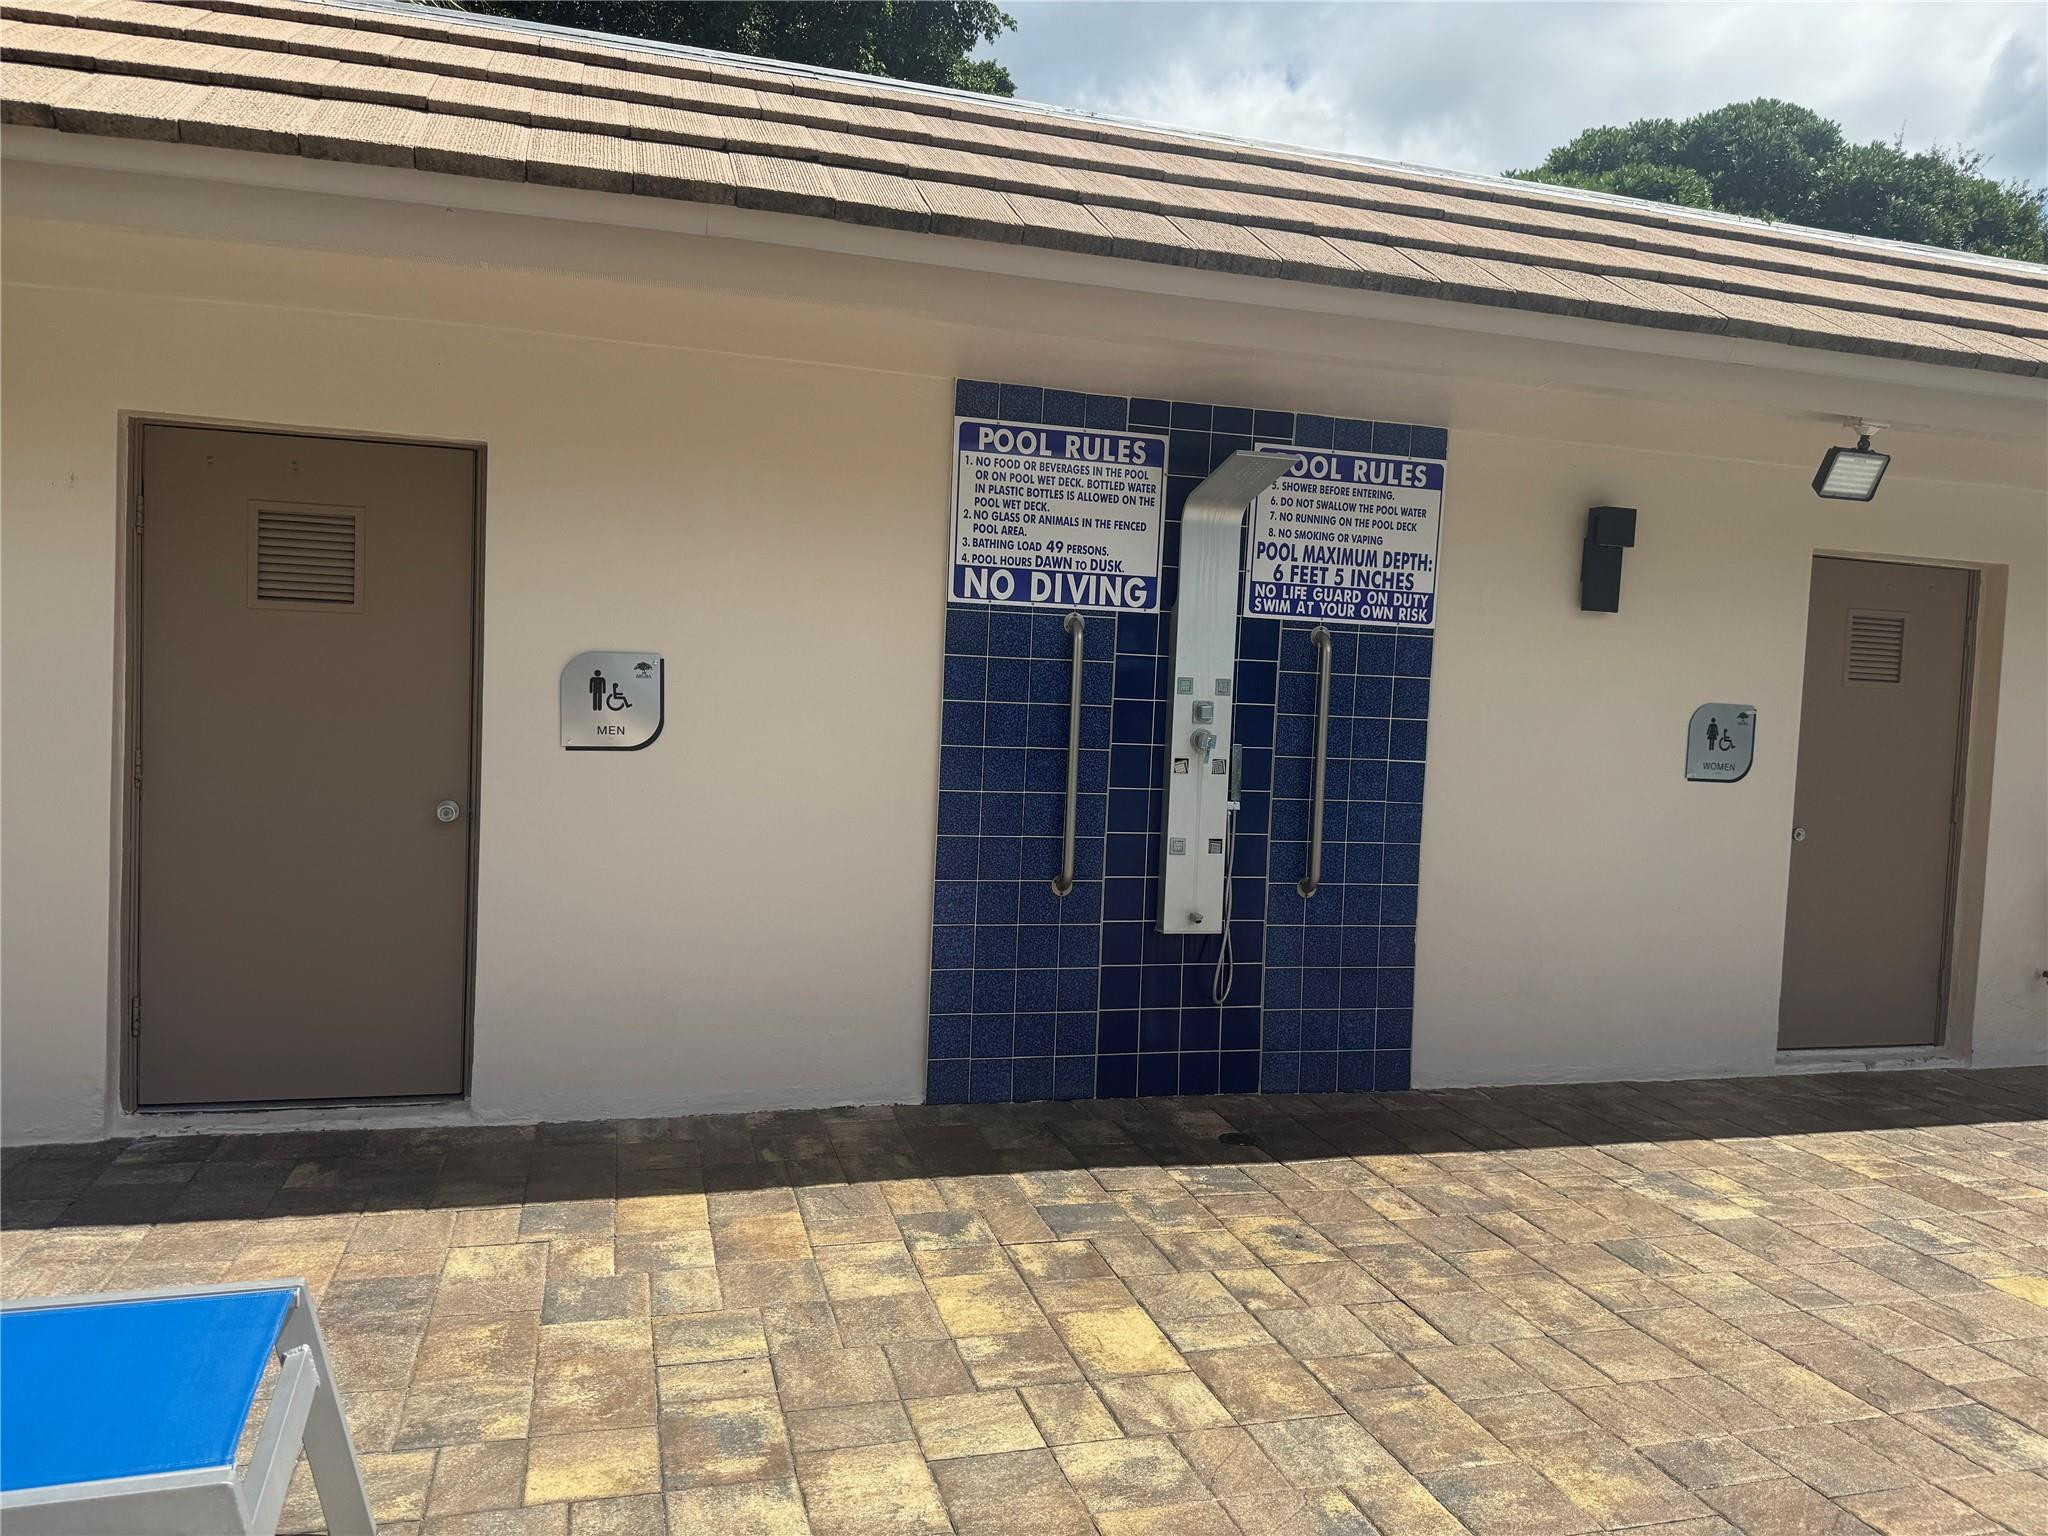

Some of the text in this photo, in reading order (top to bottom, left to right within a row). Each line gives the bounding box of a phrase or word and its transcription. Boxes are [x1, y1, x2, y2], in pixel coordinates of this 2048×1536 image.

[979, 427, 1146, 464] POOL RULES
[965, 455, 1149, 480] 1. NO FOOD OR BEVERAGES IN THE POOL
[1278, 452, 1427, 488] OOL RULES
[976, 470, 1156, 494] OR ON POOL WET DECK. BOTTLED WATER
[1282, 481, 1317, 493] SHOWER
[1320, 485, 1350, 496] BEFORE
[1352, 488, 1395, 500] ENTERING.
[974, 497, 1050, 512] POOL WET DECK.
[975, 484, 1155, 506] IN PLASTIC BOTTLES IS ALLOWED ON THE
[1271, 496, 1427, 518] 6. DO NOT SWALLOW THE POOL WATER
[963, 509, 1147, 531] 2. NO GLASS OR ANIMALS IN THE FENCED
[973, 524, 1027, 536] POOL AREA.
[1270, 511, 1417, 532] 7. NO RUNNING ON THE POOL DECK
[962, 537, 1109, 556] 3. BATHING LOAD 49 PERSONS.
[1268, 528, 1383, 545] 8. NO SMOKING OR VAPING
[961, 553, 970, 563] 4.
[971, 554, 997, 565] POOL
[1000, 556, 1032, 567] HOURS
[1035, 555, 1072, 569] DAWN
[1090, 559, 1125, 573] DUSK.
[1257, 541, 1433, 572] POOL MAXIMUM DEPTH:
[964, 567, 1148, 608] NO DIVING
[1273, 564, 1414, 591] 6 FEET 5 INCHES
[1255, 584, 1429, 608] NO LIFE GUARD ON DUTY
[1254, 598, 1427, 622] SWIM AT YOUR OWN RISK
[597, 725, 625, 735] MEN
[1703, 762, 1735, 771] WOMEN
